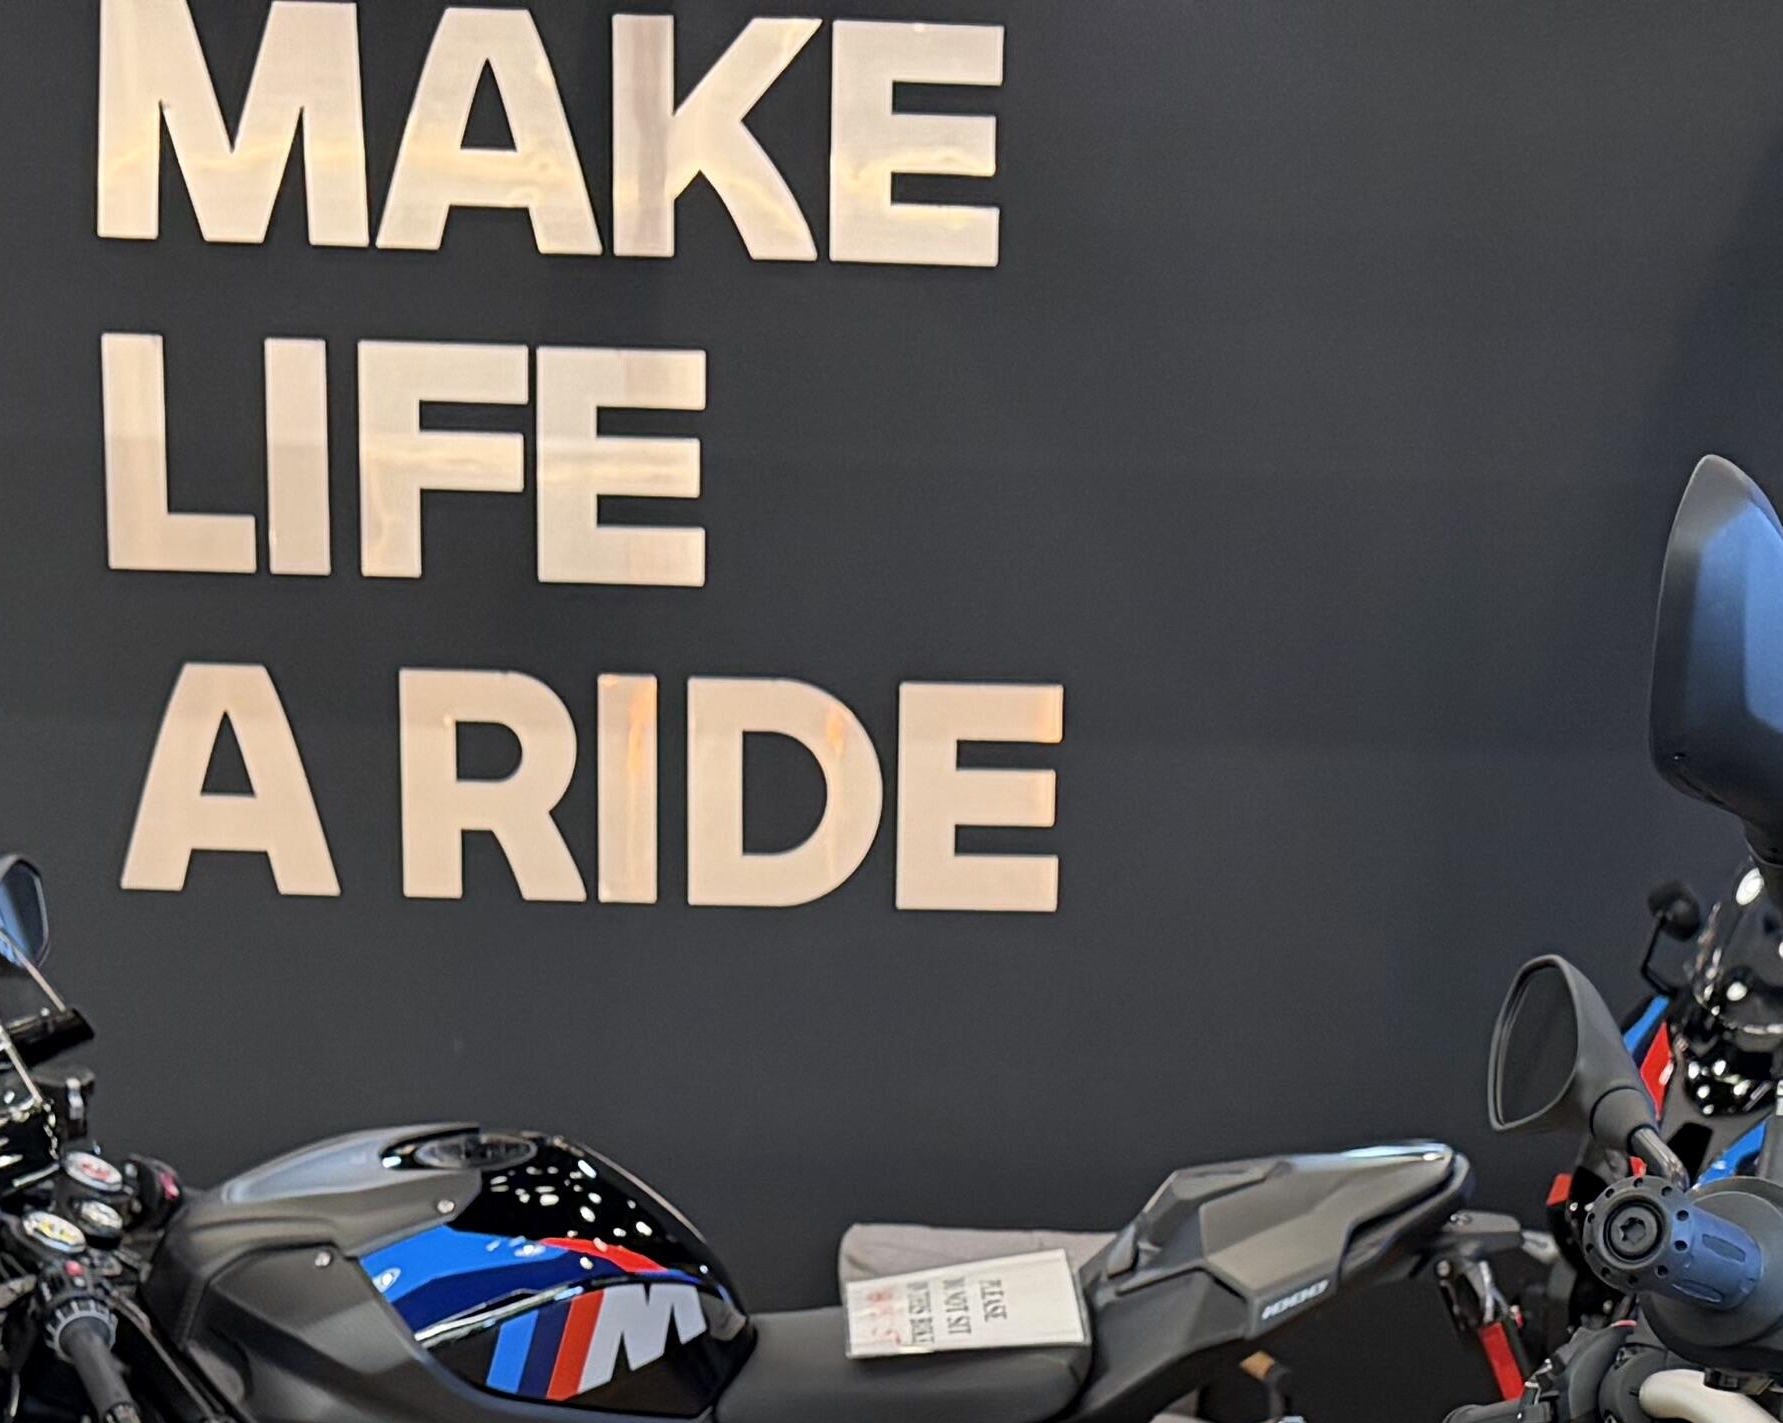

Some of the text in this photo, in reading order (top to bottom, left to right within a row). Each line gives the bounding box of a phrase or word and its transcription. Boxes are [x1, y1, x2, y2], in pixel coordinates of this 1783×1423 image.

[97, 0, 1004, 266] MAKE
[101, 332, 706, 586] LIFE
[120, 661, 1064, 911] A RIDE
